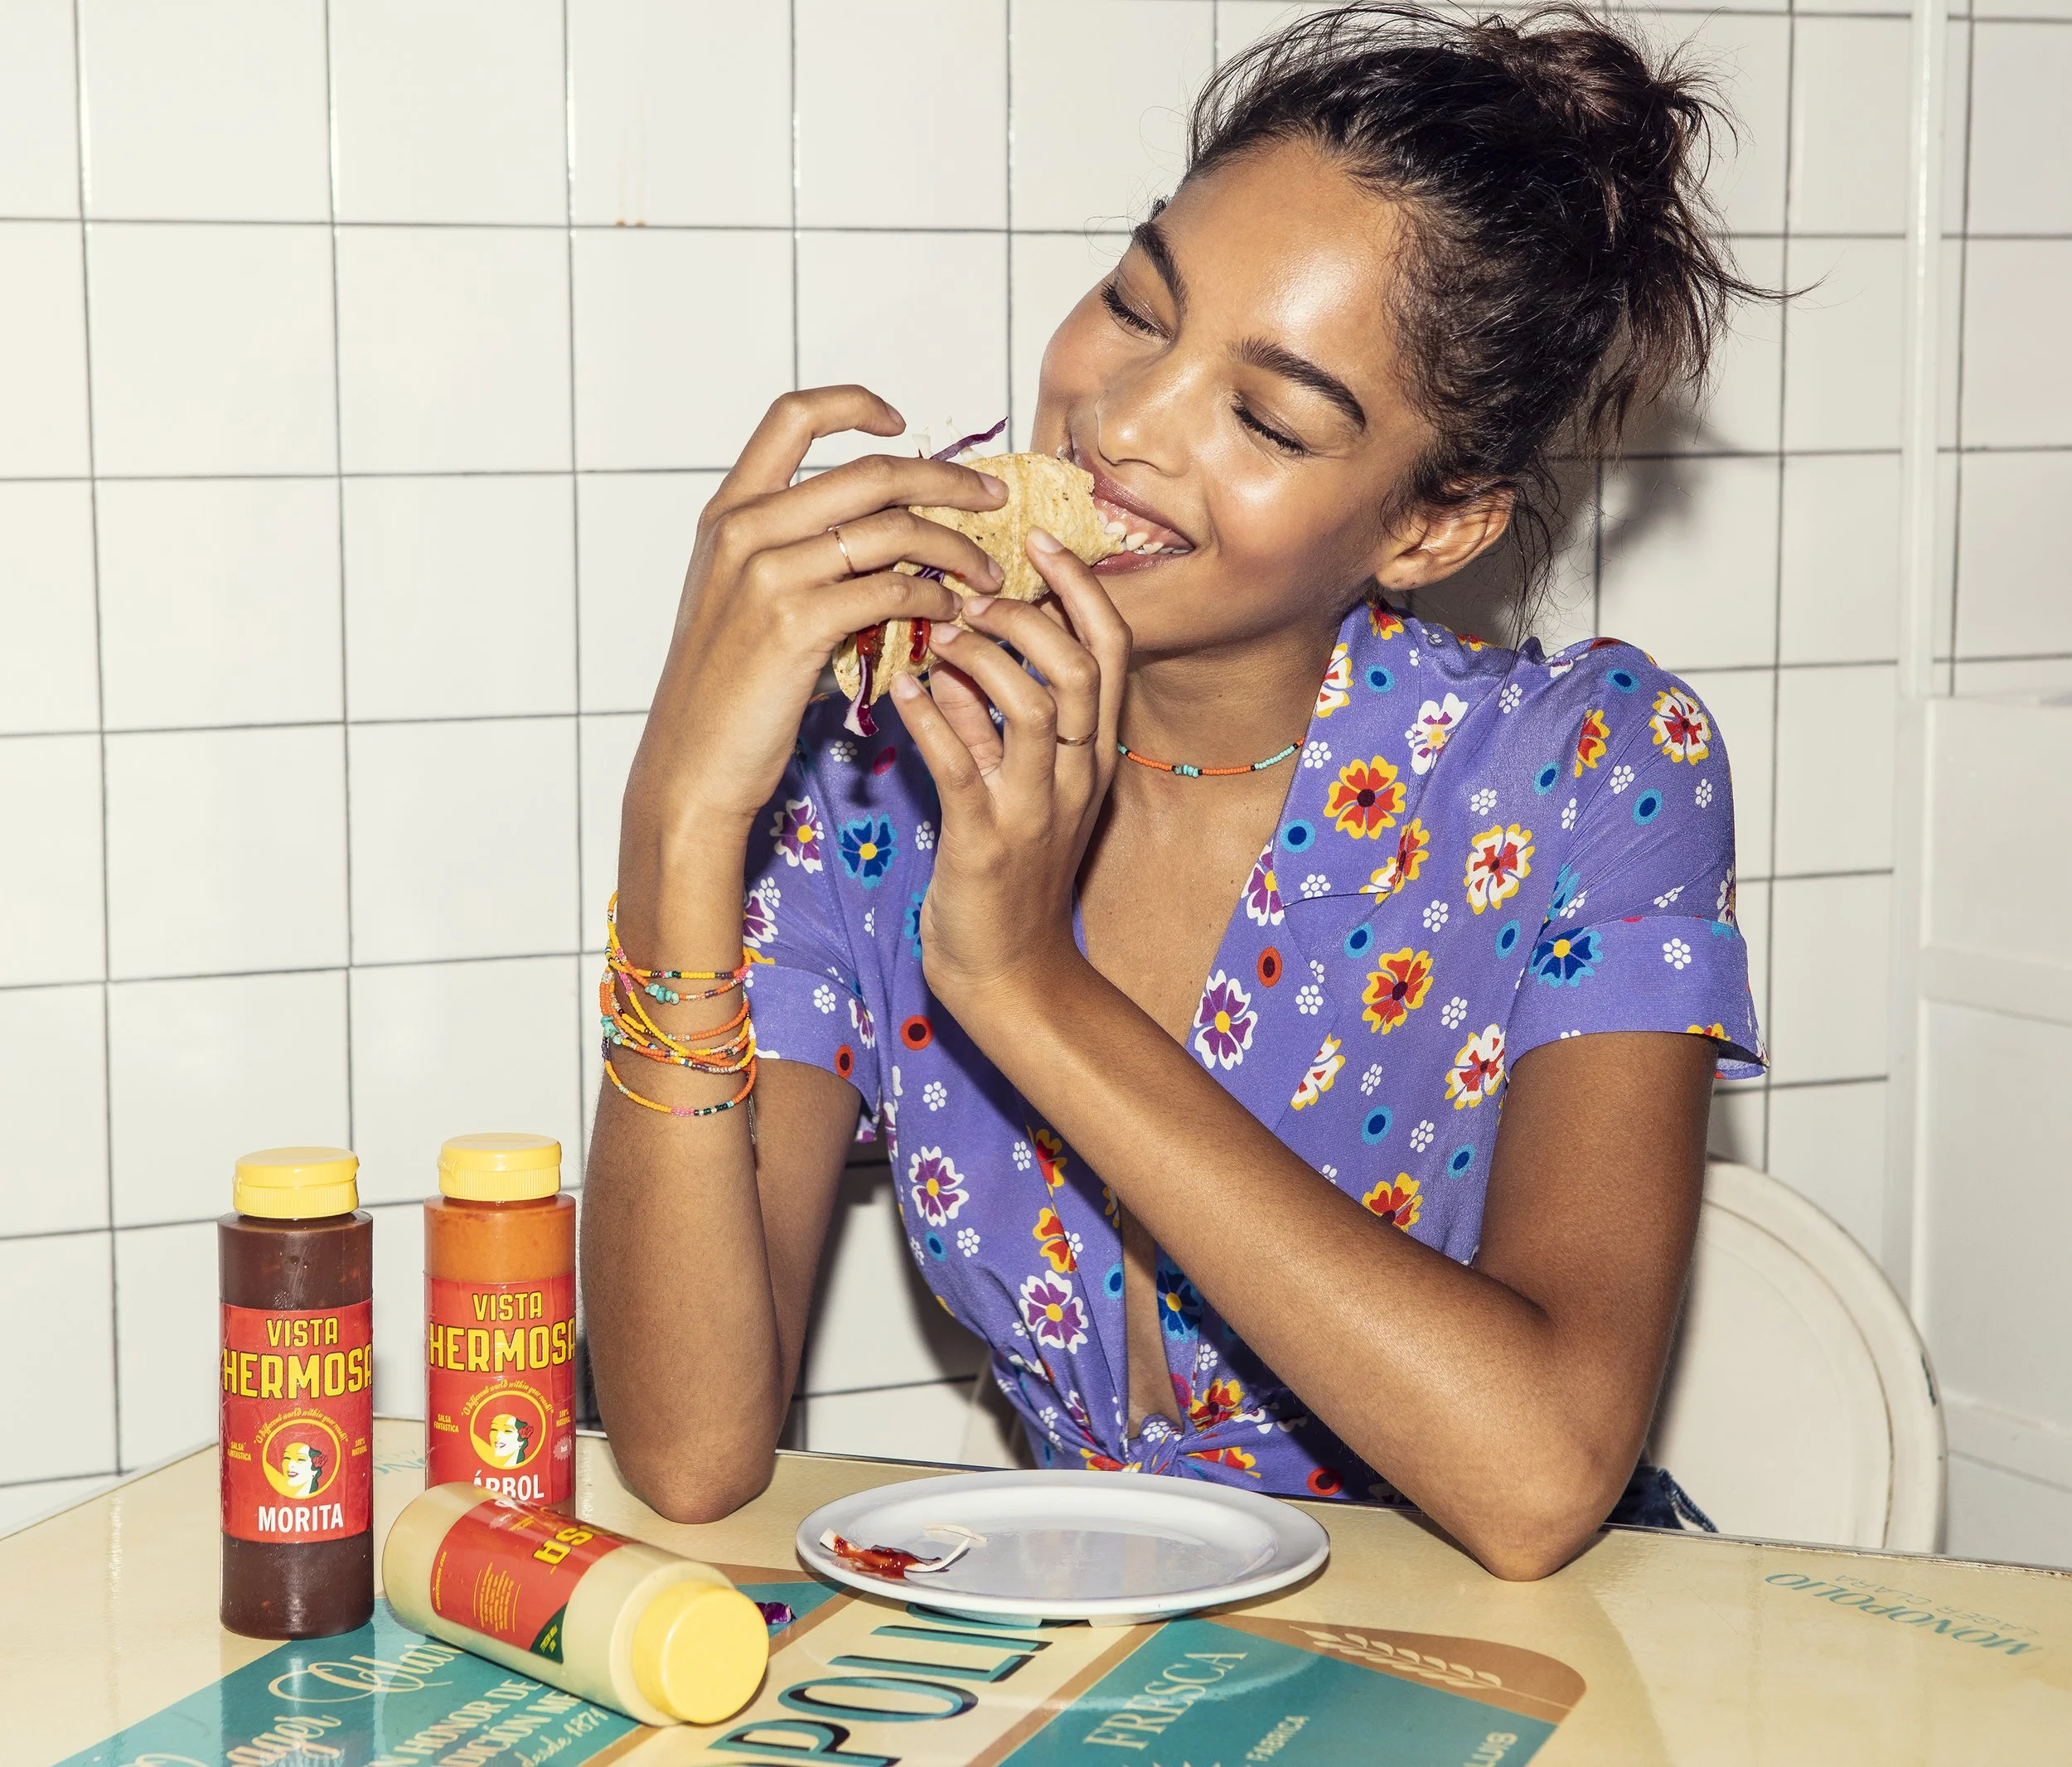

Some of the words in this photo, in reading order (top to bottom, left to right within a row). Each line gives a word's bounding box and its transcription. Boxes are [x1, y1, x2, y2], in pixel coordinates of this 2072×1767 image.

[472, 1290, 543, 1322] VISTA
[266, 1317, 338, 1348] VISTA
[429, 1316, 575, 1372] HERMOSA
[223, 1343, 372, 1399] HERMOSA
[437, 1413, 452, 1424] SALSA
[226, 1450, 252, 1462] FANTASTICA
[230, 1441, 244, 1451] SALSA
[257, 1503, 344, 1532] MORITA
[1835, 1574, 1932, 1605] CLARA
[1765, 1572, 2044, 1655] MONOPOLIO
[269, 1643, 467, 1703] Clar
[394, 1700, 511, 1755] HONOR
[483, 1678, 544, 1702] DE
[1082, 1652, 1248, 1750] FRESCA
[563, 1707, 609, 1738] 1871
[429, 1714, 552, 1767] DICIÓN
